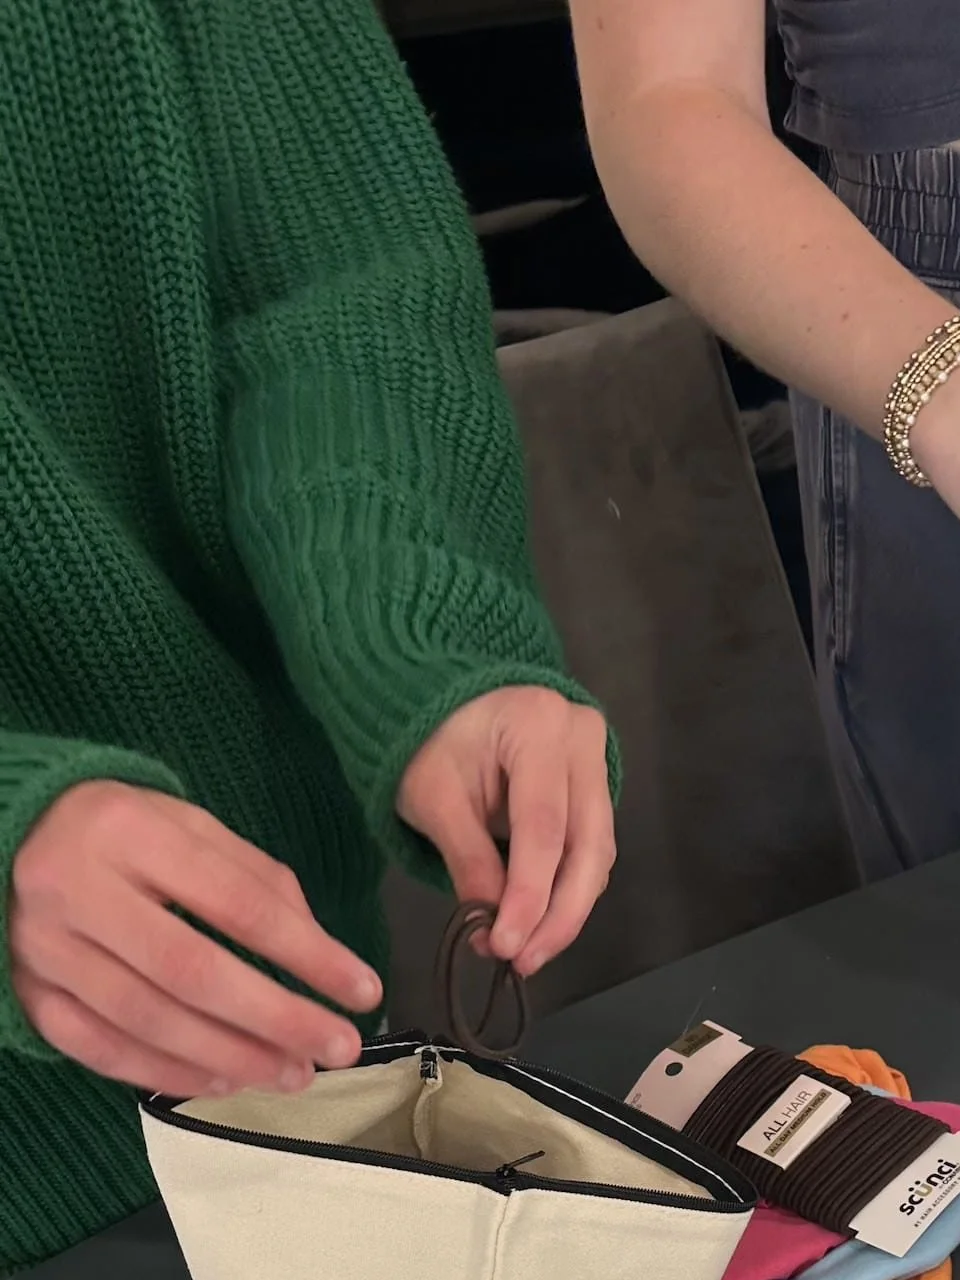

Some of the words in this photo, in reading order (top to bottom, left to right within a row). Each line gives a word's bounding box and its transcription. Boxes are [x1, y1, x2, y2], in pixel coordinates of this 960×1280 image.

[761, 1114, 788, 1141] ALL
[780, 1087, 812, 1120] HAIR
[769, 1140, 781, 1153] ALL
[779, 1129, 791, 1141] DAY
[789, 1106, 813, 1130] MEDIUM
[897, 1153, 956, 1217] scünci
